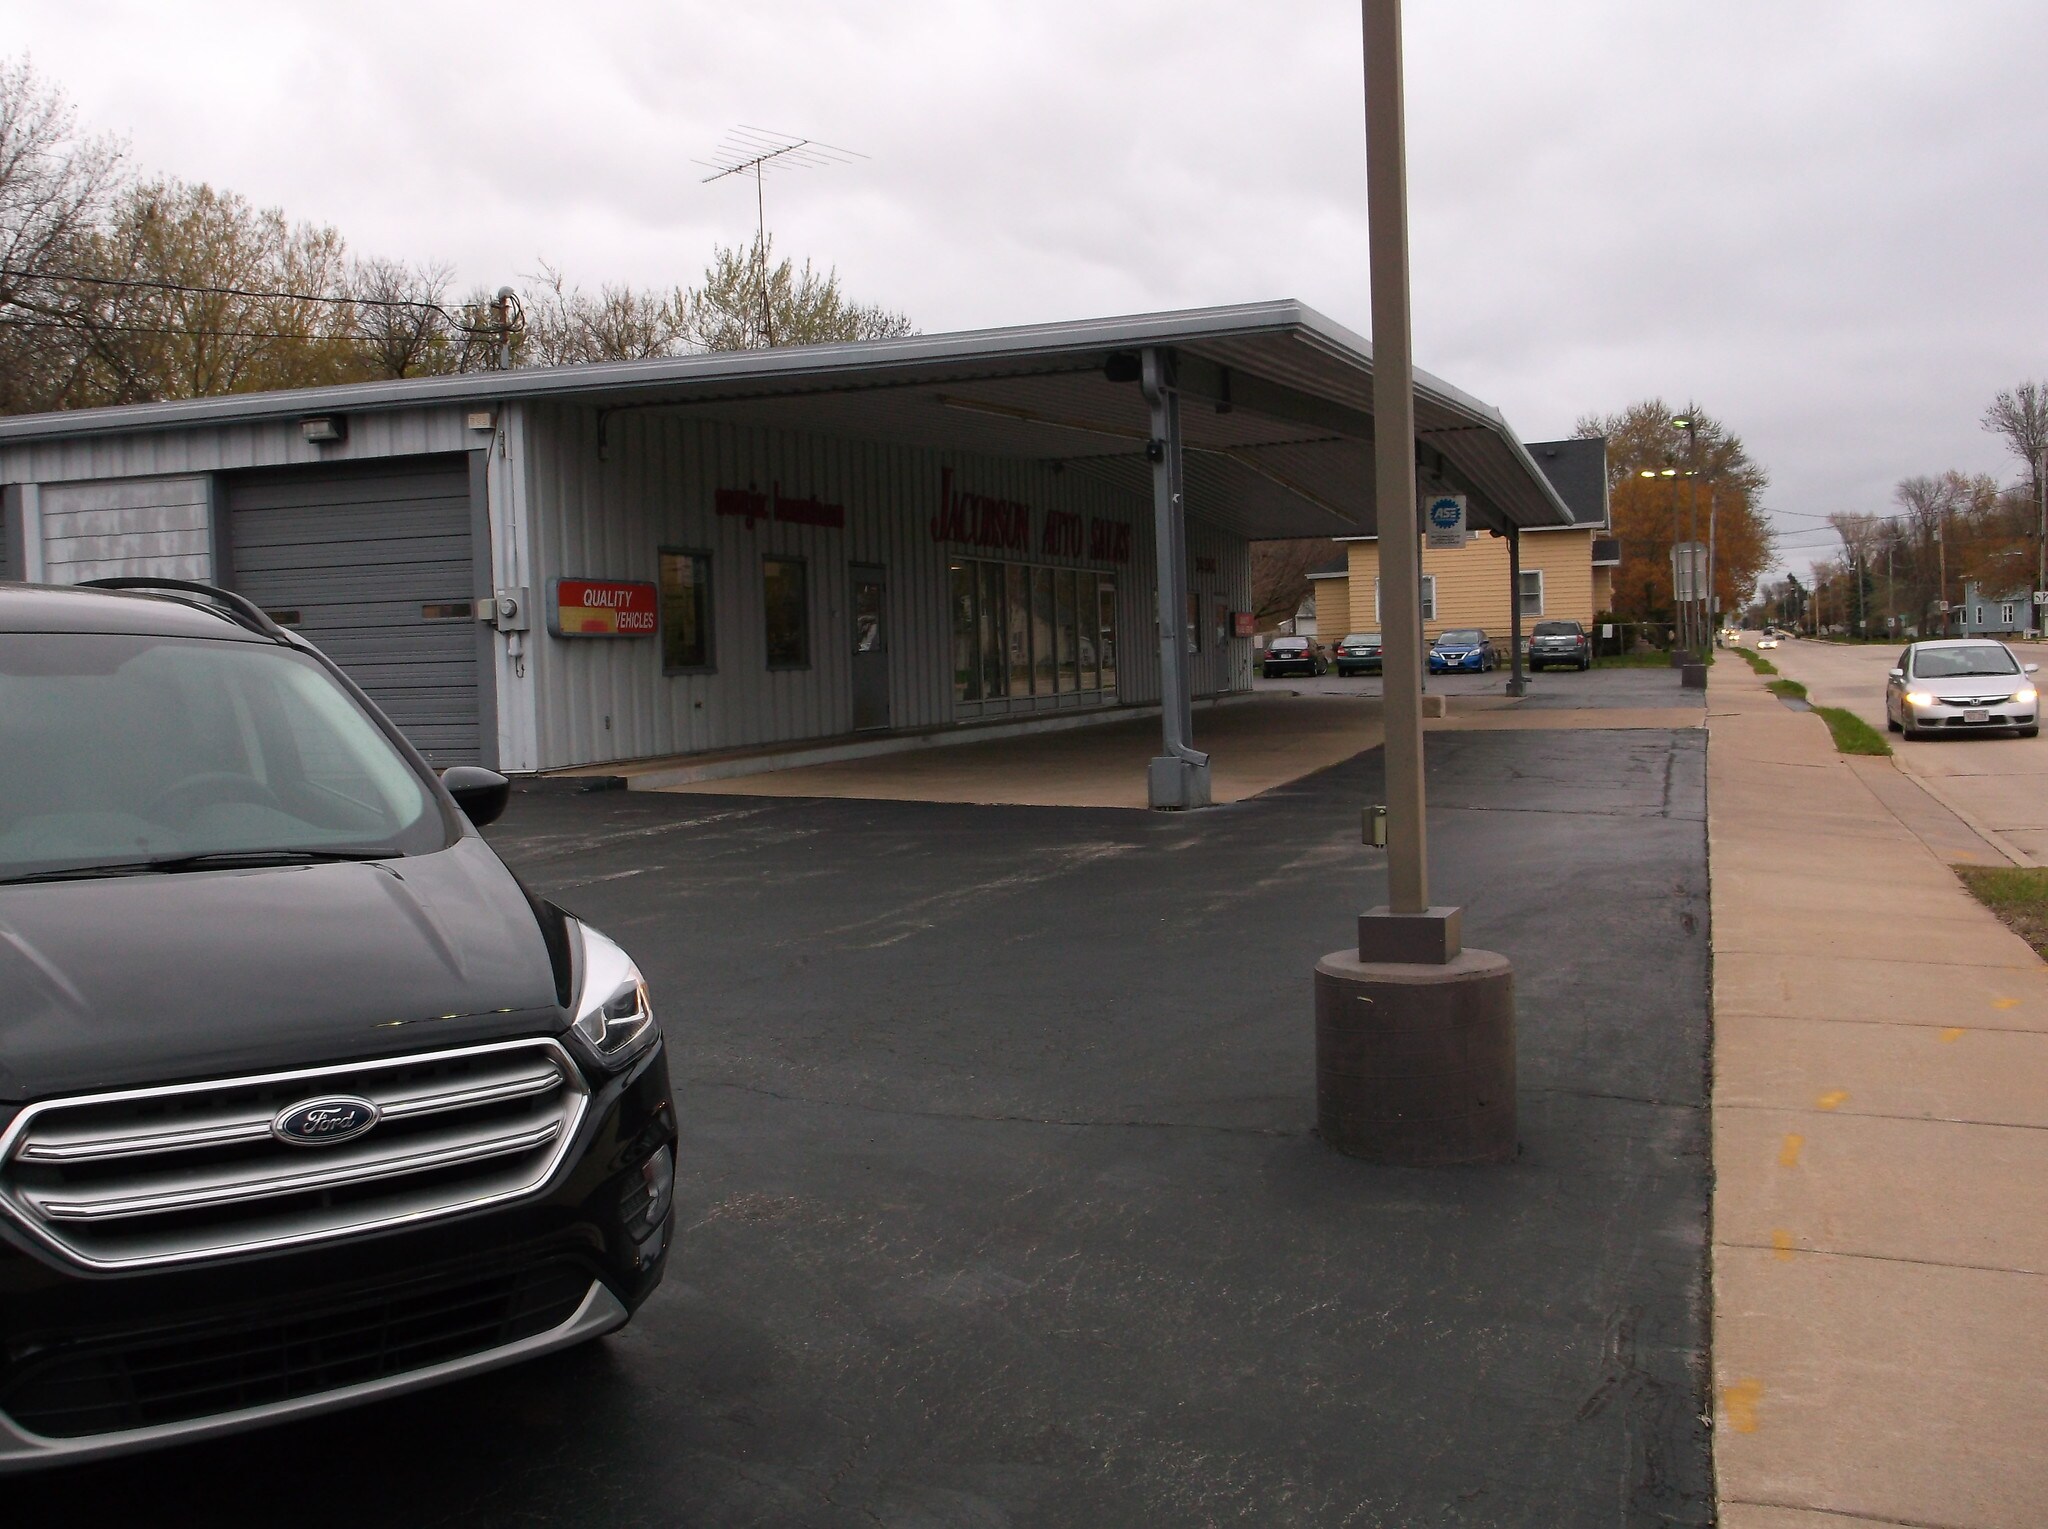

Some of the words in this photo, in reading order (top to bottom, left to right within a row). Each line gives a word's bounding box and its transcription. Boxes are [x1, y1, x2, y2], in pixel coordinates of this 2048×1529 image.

[1434, 507, 1457, 518] ASE
[1042, 509, 1083, 558] AUTO
[583, 588, 633, 607] QUALITY
[303, 1107, 356, 1134] Ford
